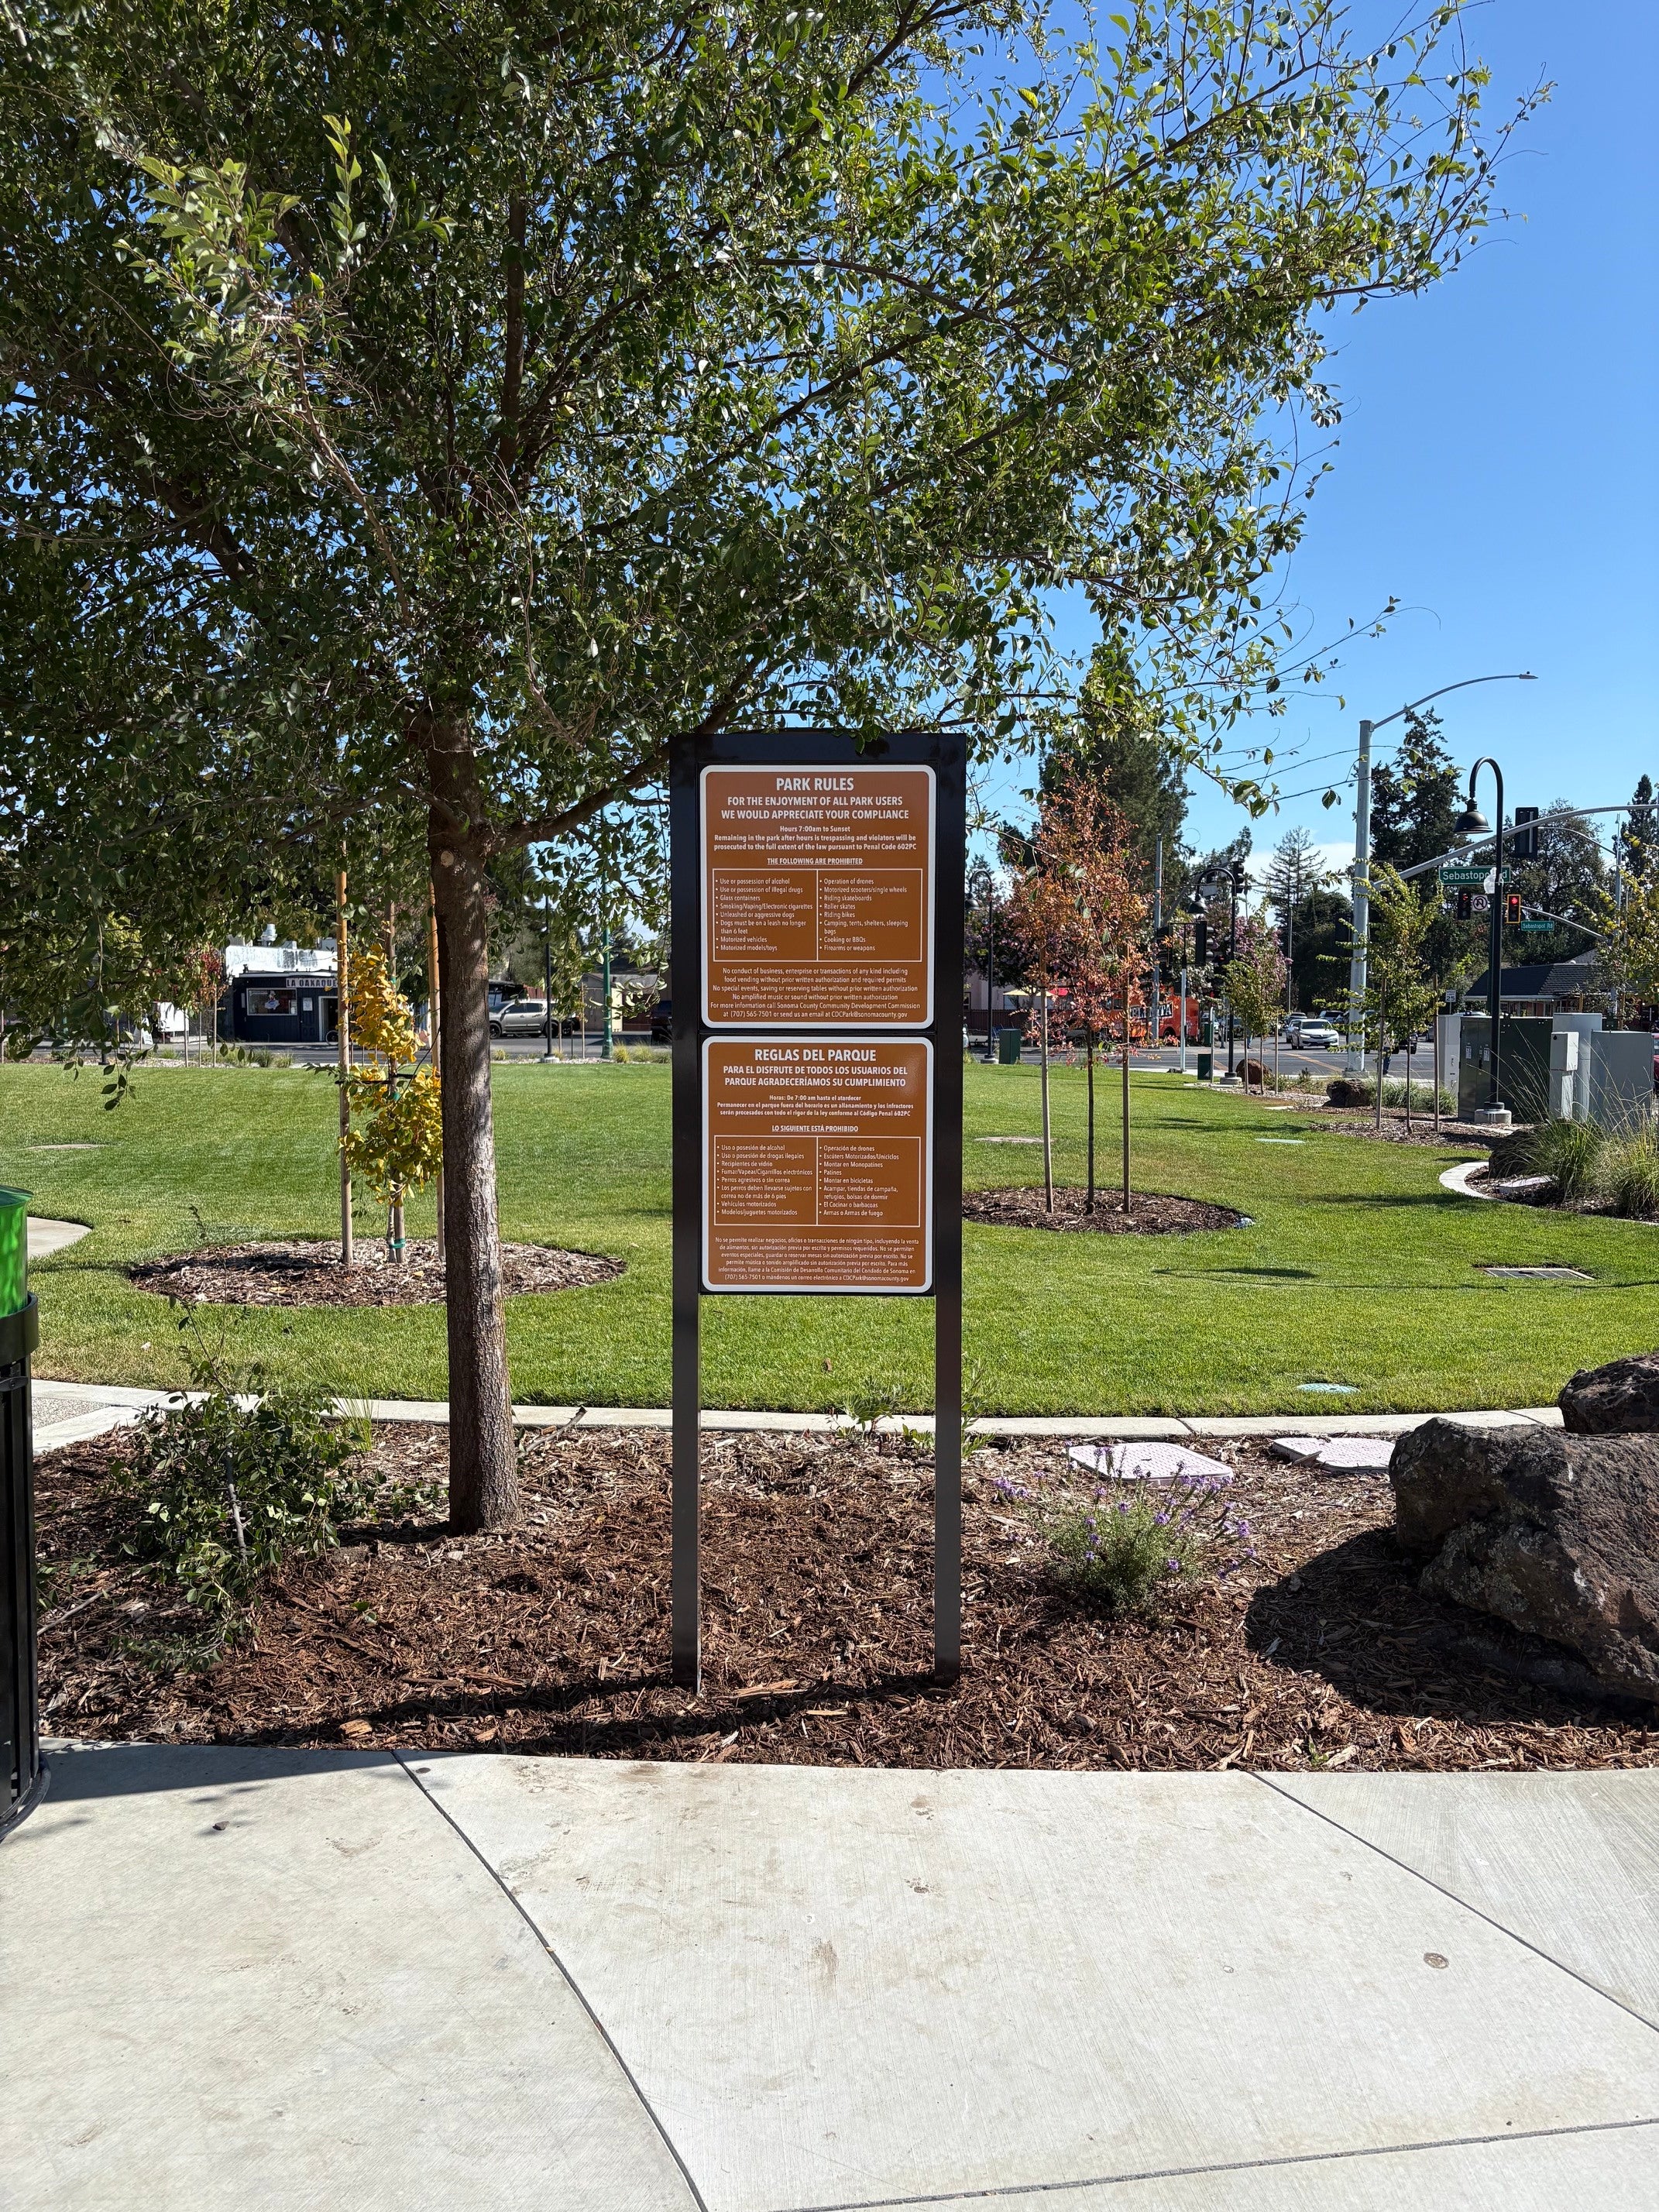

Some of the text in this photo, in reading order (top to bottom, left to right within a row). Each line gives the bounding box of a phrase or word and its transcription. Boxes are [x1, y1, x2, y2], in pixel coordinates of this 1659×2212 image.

[777, 778, 854, 791] PARK RULES
[728, 797, 902, 805] FOR THE ENJOYMENT OF ALL PARK USERS
[721, 810, 909, 819] WE WOULD APPRECIATE YOUR COMPLIANCE
[1443, 871, 1489, 881] Sebastopo
[755, 1049, 876, 1061] REGLAS DEL PARQUE
[758, 1076, 831, 1086] AGRADECERÍAMOS
